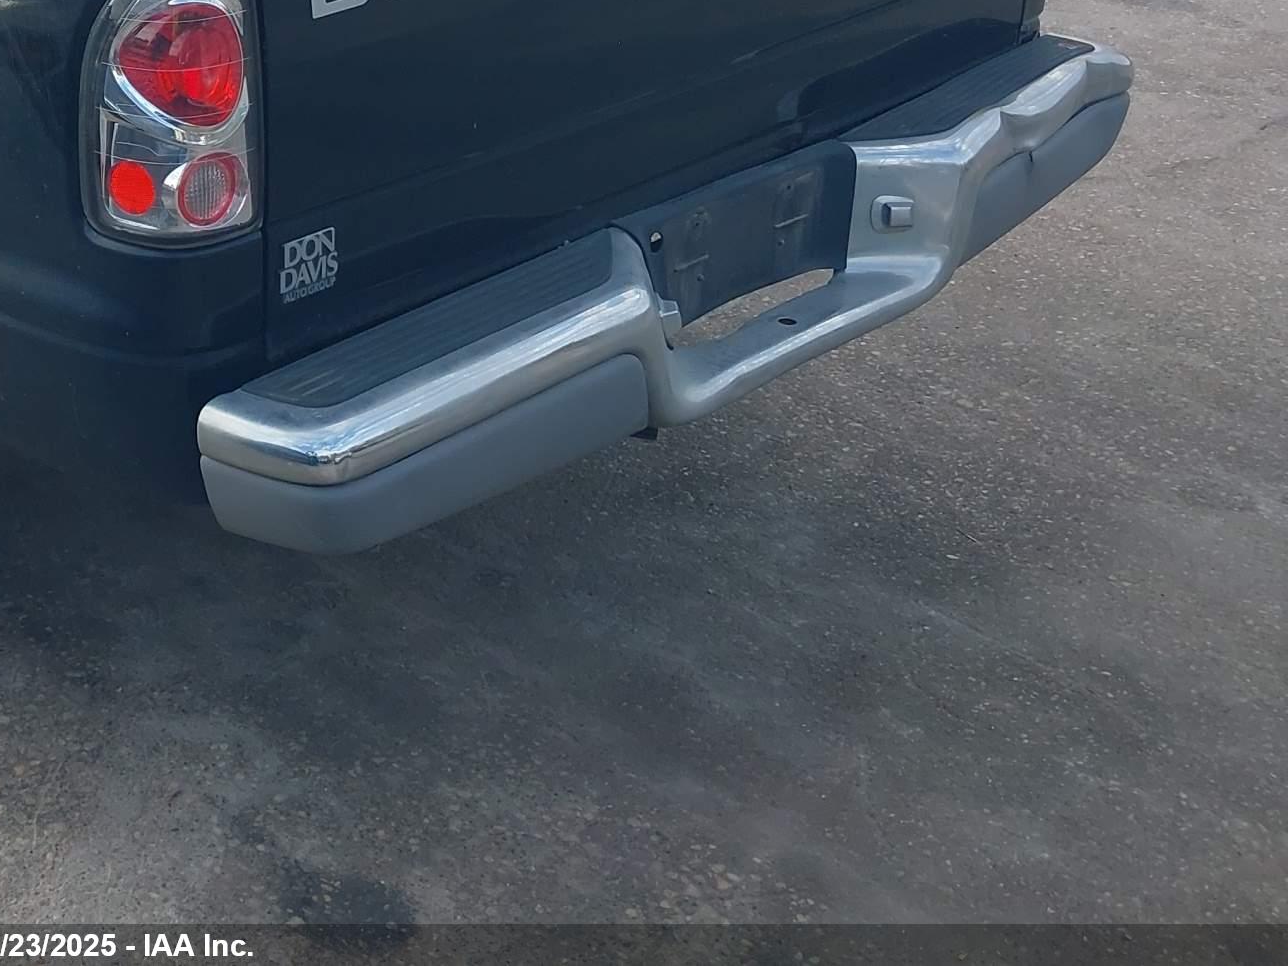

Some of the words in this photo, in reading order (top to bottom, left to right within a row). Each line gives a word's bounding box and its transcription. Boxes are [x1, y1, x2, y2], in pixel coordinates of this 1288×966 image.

[283, 227, 336, 269] DON
[280, 251, 339, 294] DAVIS
[283, 287, 308, 304] AUTO
[307, 276, 336, 295] GROUP
